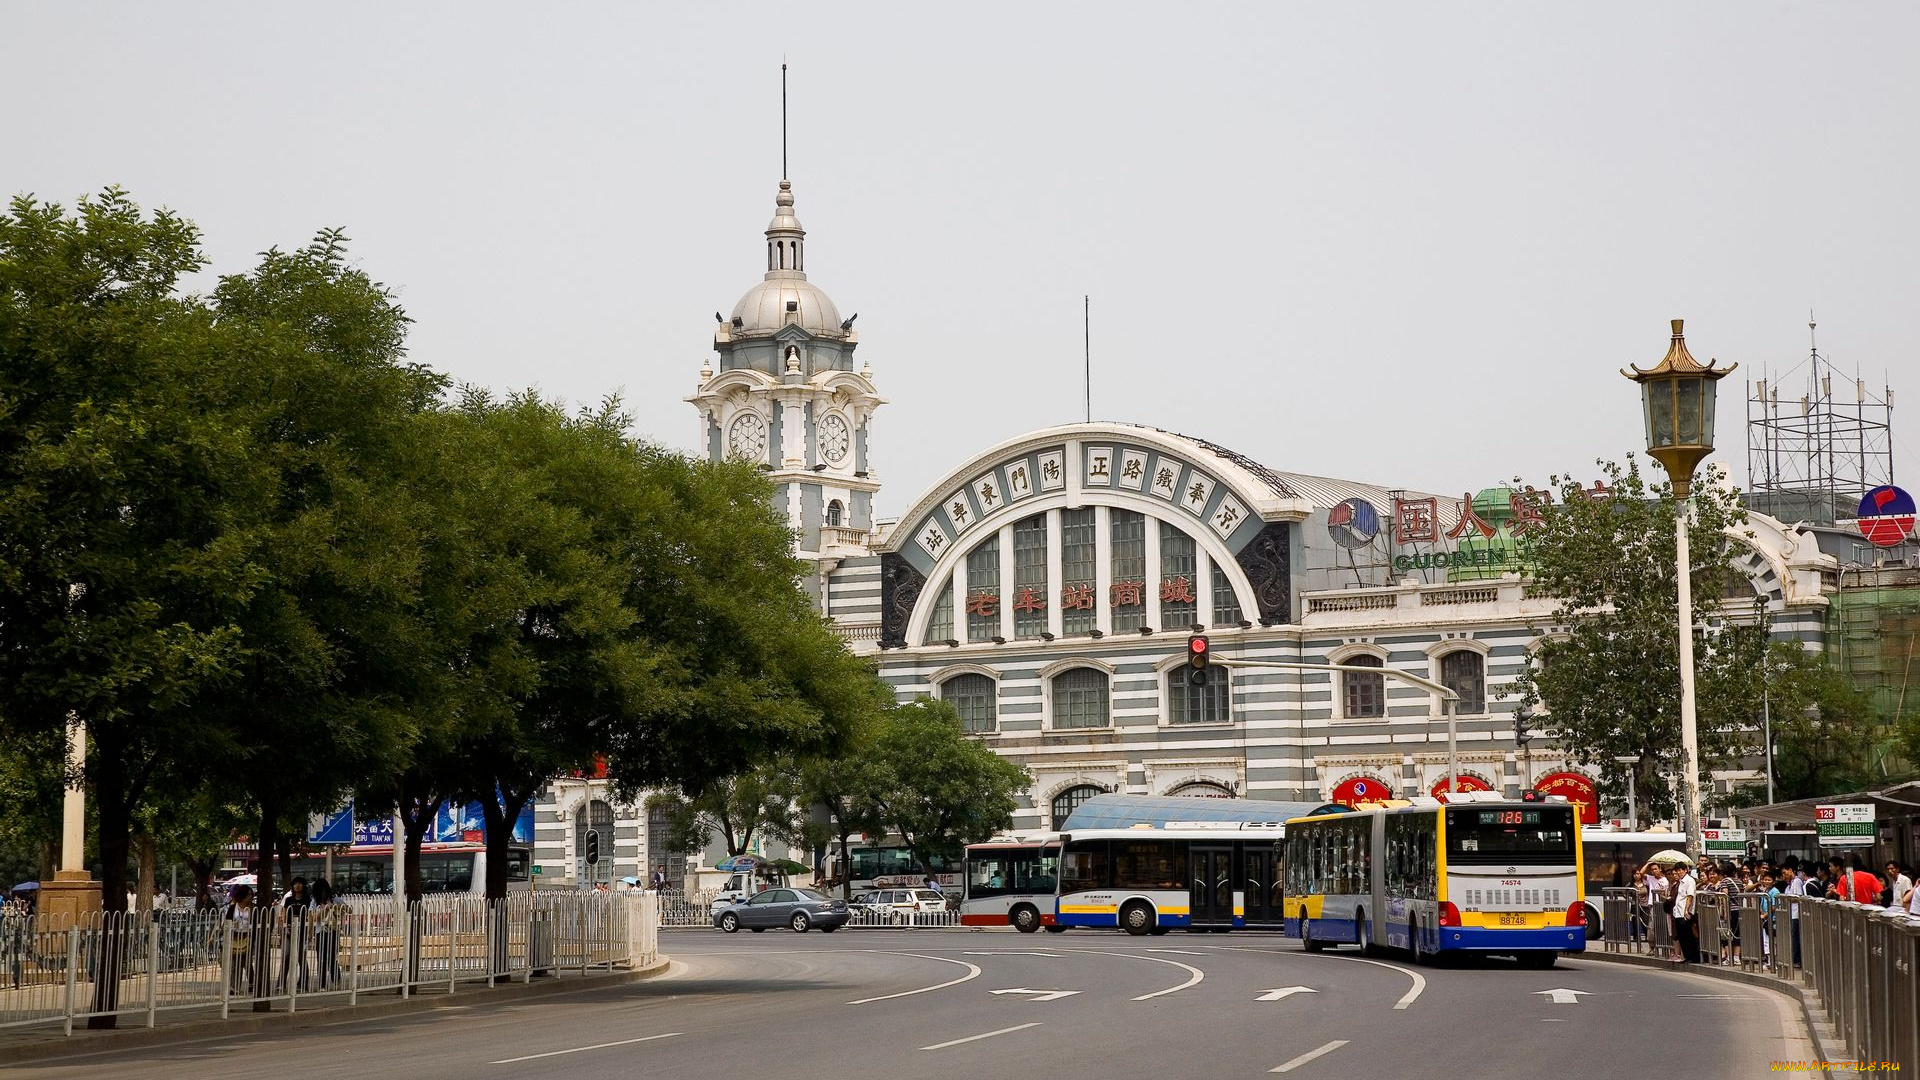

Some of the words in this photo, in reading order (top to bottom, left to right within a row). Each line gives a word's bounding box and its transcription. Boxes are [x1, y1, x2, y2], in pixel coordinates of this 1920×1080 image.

[1395, 548, 1505, 571] GUOREN
[966, 576, 1197, 616] 老车站商城
[1499, 811, 1523, 824] 126
[1819, 810, 1834, 819] 126
